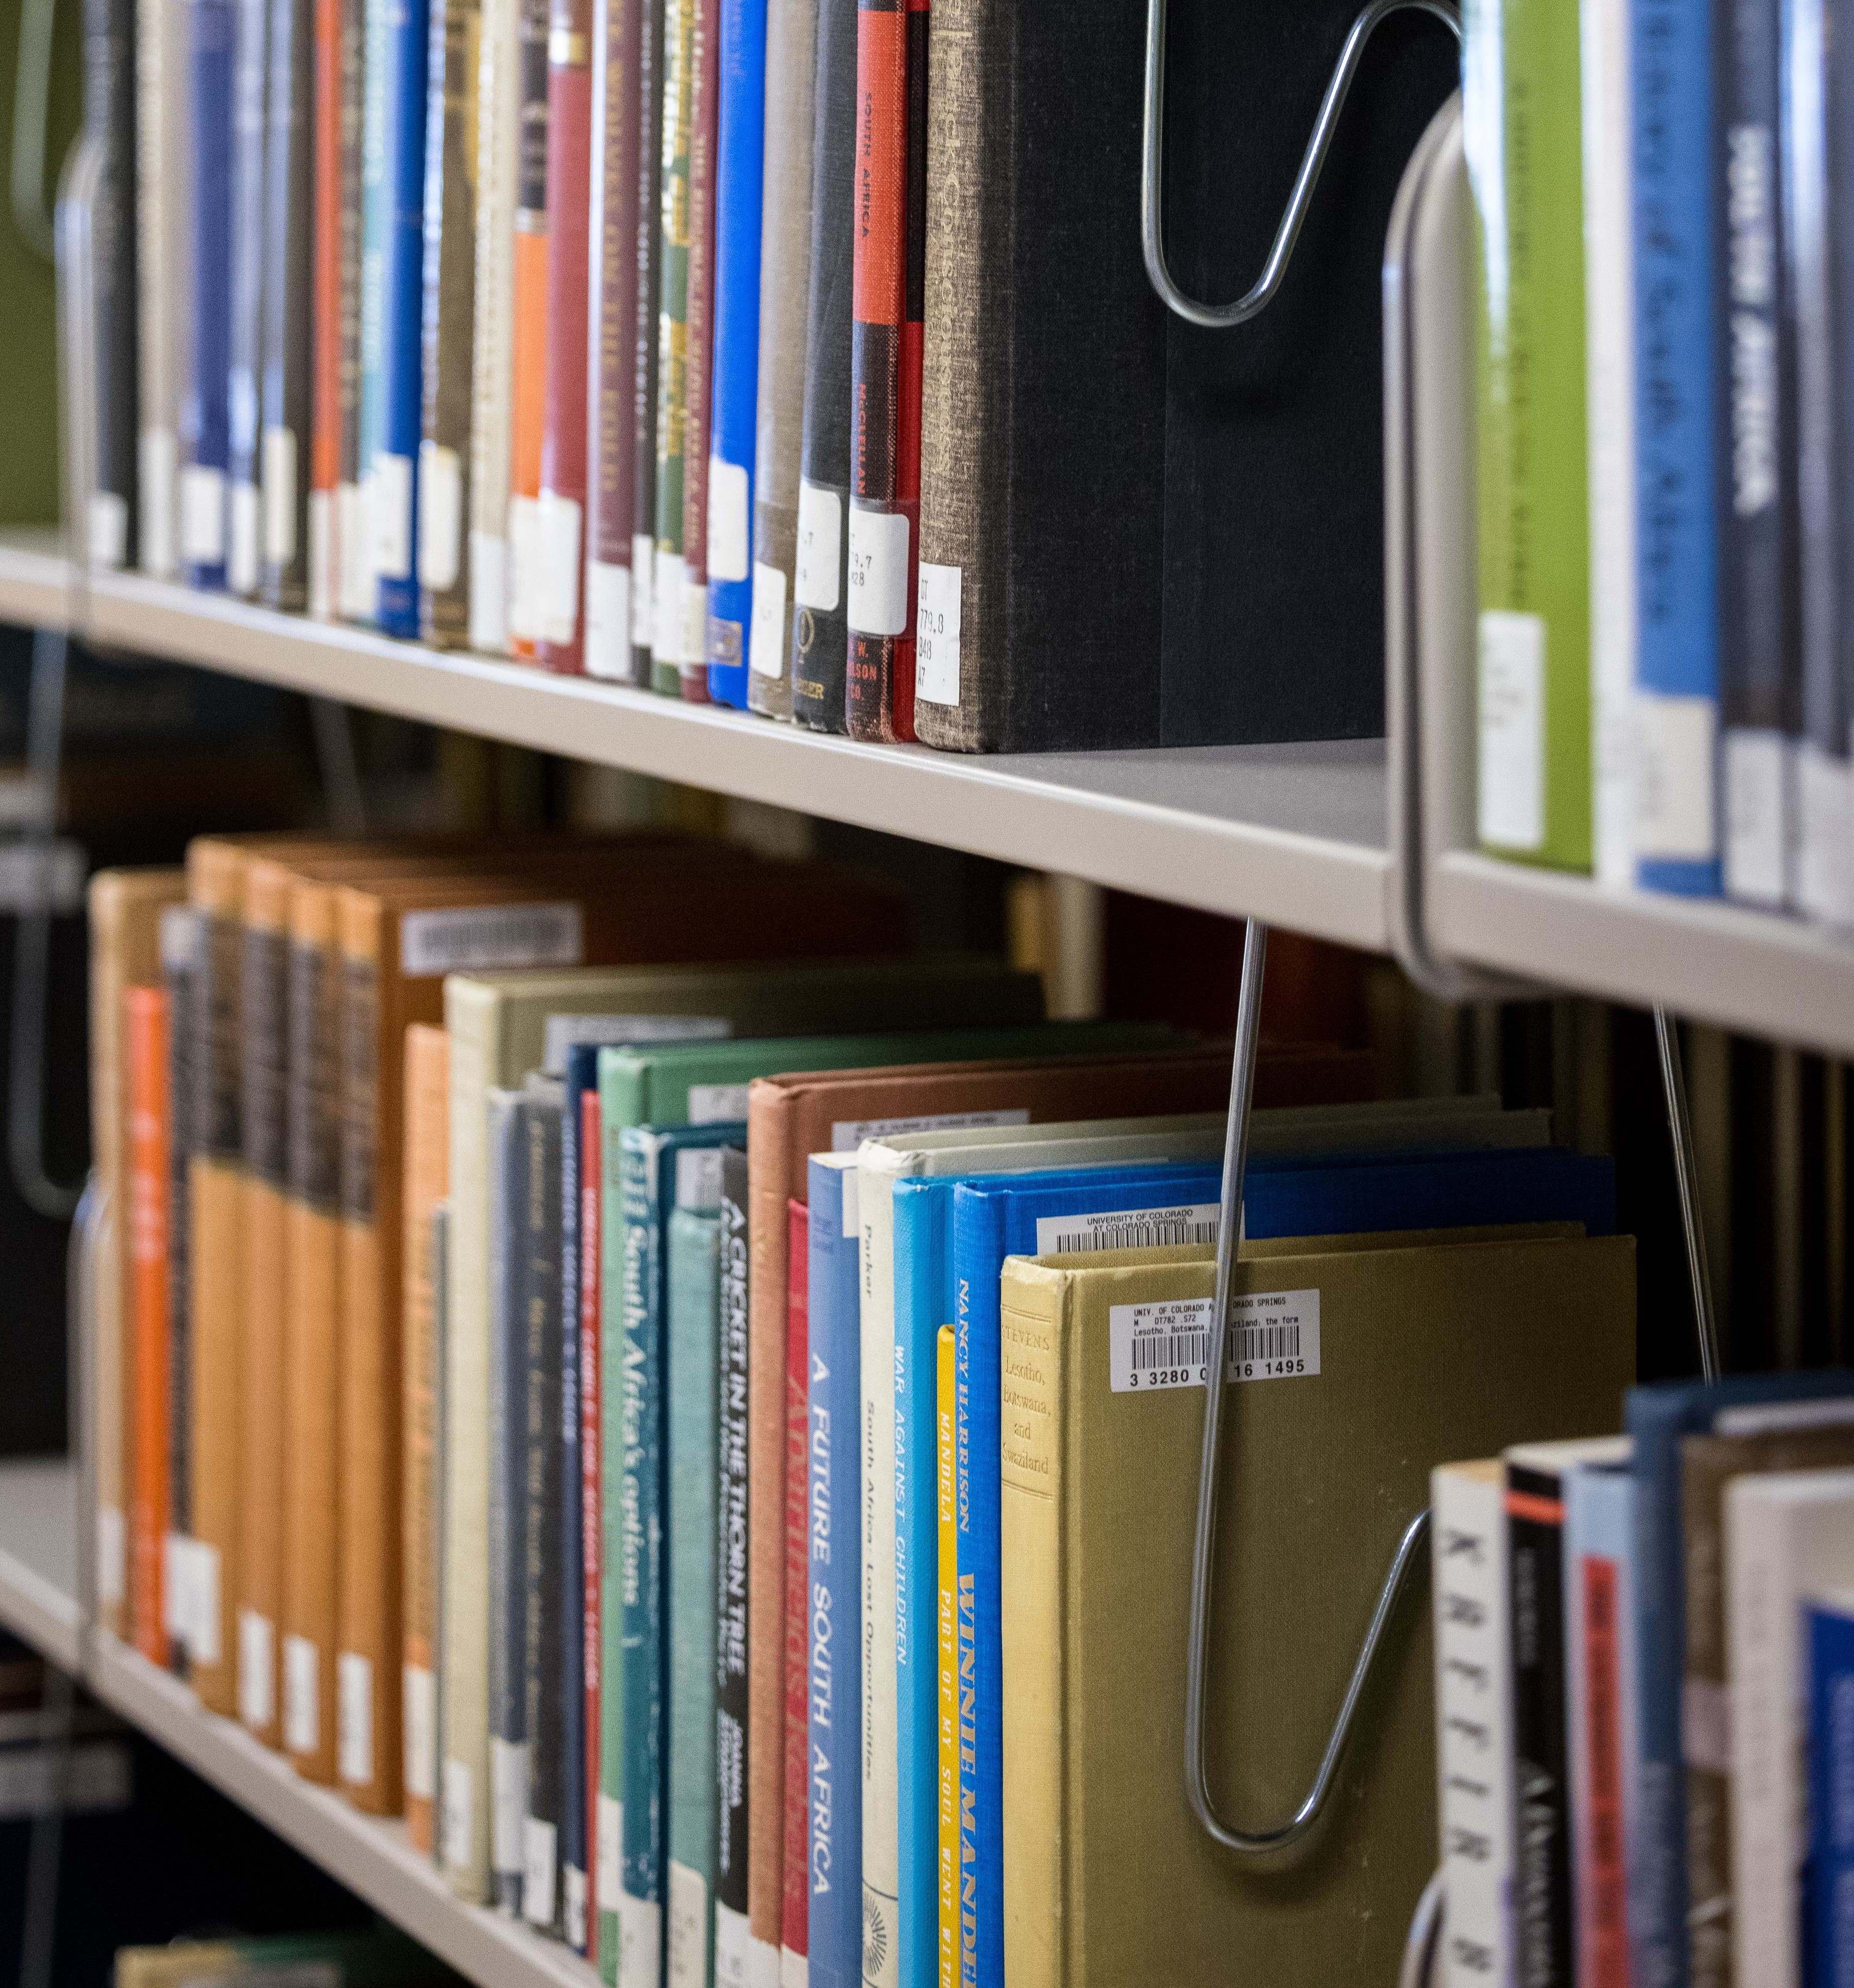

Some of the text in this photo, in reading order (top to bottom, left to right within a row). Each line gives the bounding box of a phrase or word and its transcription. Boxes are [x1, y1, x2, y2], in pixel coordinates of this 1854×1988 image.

[860, 91, 873, 238] SOUTH AFRICA
[919, 636, 931, 660] B48
[920, 608, 944, 634] 779.8
[1087, 1208, 1193, 1226] UNIVERSITY OF COLORADO
[1106, 1221, 1150, 1232] COLORADO
[1153, 1218, 1187, 1229] SPRINGS
[864, 1224, 873, 1299] Parker
[1134, 1308, 1154, 1317] UNIV.
[1159, 1306, 1167, 1315] OF
[1171, 1304, 1205, 1314] COLORADO
[1257, 1296, 1286, 1307] SPRINGS
[1155, 1316, 1175, 1325] DT782
[1266, 1317, 1278, 1326] the
[1282, 1316, 1299, 1324] form
[1130, 1373, 1138, 1386] 3
[1149, 1369, 1189, 1385] 3280
[1265, 1359, 1304, 1375] 1495
[867, 1399, 875, 1469] South
[958, 1278, 970, 1533] NANCY HARRISON
[1014, 1422, 1031, 1441] and
[727, 1202, 748, 1678] A CRICKET IN THE THORN TREE
[940, 1411, 951, 1523] MANDELA
[1002, 1442, 1049, 1475] Swaziland
[894, 1345, 907, 1665] WAR AGAINST CHILDREN
[866, 1563, 875, 1612] Lost
[812, 1352, 832, 1895] A FUTURE SOUTH AFRICA
[865, 1621, 875, 1781] Opportunities
[958, 1573, 976, 1776] WINNIE
[940, 1589, 951, 1988] PART OF MY SOUL WENT WITH
